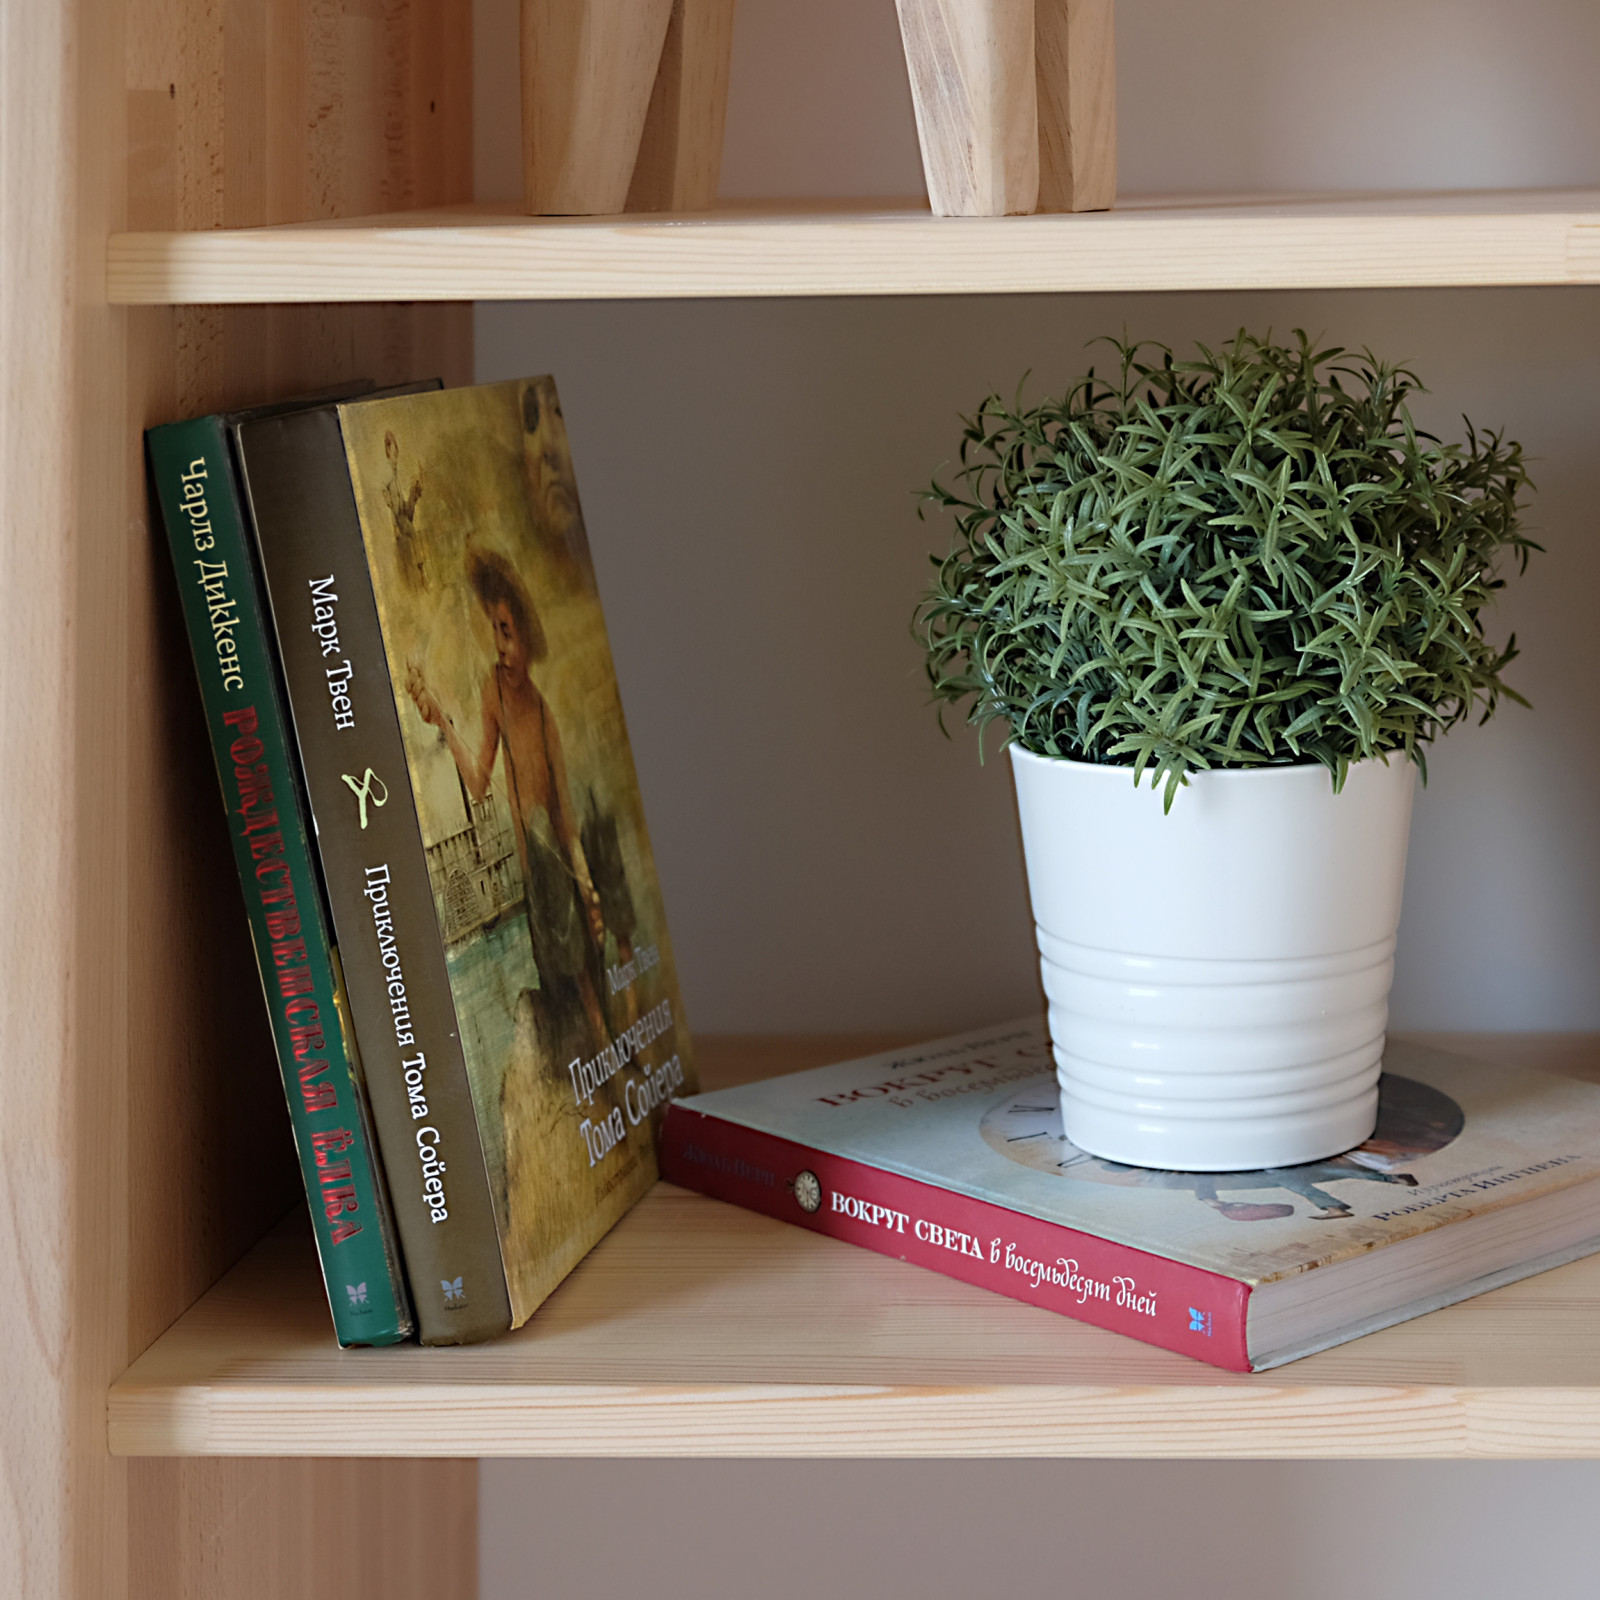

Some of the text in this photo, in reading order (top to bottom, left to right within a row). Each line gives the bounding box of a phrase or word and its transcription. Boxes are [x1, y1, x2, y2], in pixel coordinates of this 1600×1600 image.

[180, 456, 244, 692] Чарлз Диккенс
[309, 574, 355, 730] Марк Твен
[223, 705, 363, 1246] РОЖДЕСТВЕНСКАЯ ЁЛКА
[607, 960, 638, 995] Марк
[364, 863, 449, 1224] Приключения Тома Сойера
[569, 998, 674, 1106] Приключения
[816, 1055, 998, 1108] ВОКРУГ
[580, 1054, 685, 1168] Тома Сойера
[831, 1191, 1156, 1316] ВОКРУГ СВЕТА в восемьдесят дней
